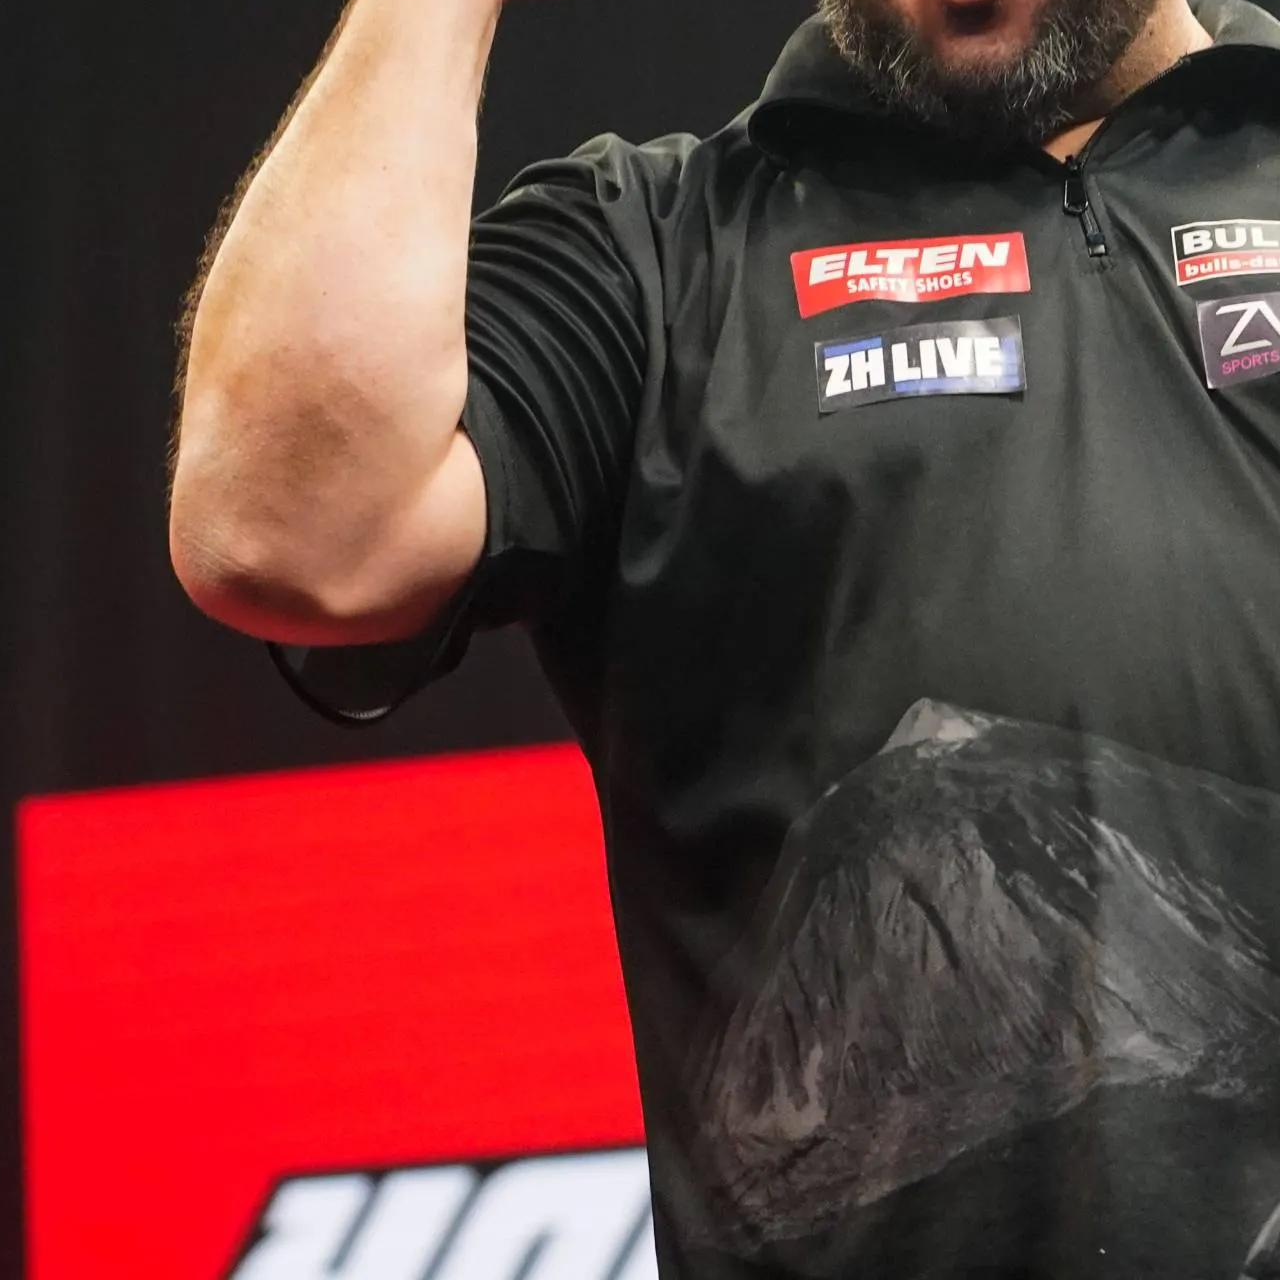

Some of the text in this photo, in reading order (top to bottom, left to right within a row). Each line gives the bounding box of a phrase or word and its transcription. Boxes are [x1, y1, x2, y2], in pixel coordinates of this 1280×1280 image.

[808, 241, 1010, 286] ELTEN
[847, 271, 972, 294] SAFETY SHOES
[824, 336, 1004, 398] ZH LIVE
[1222, 349, 1280, 375] SPORTS
